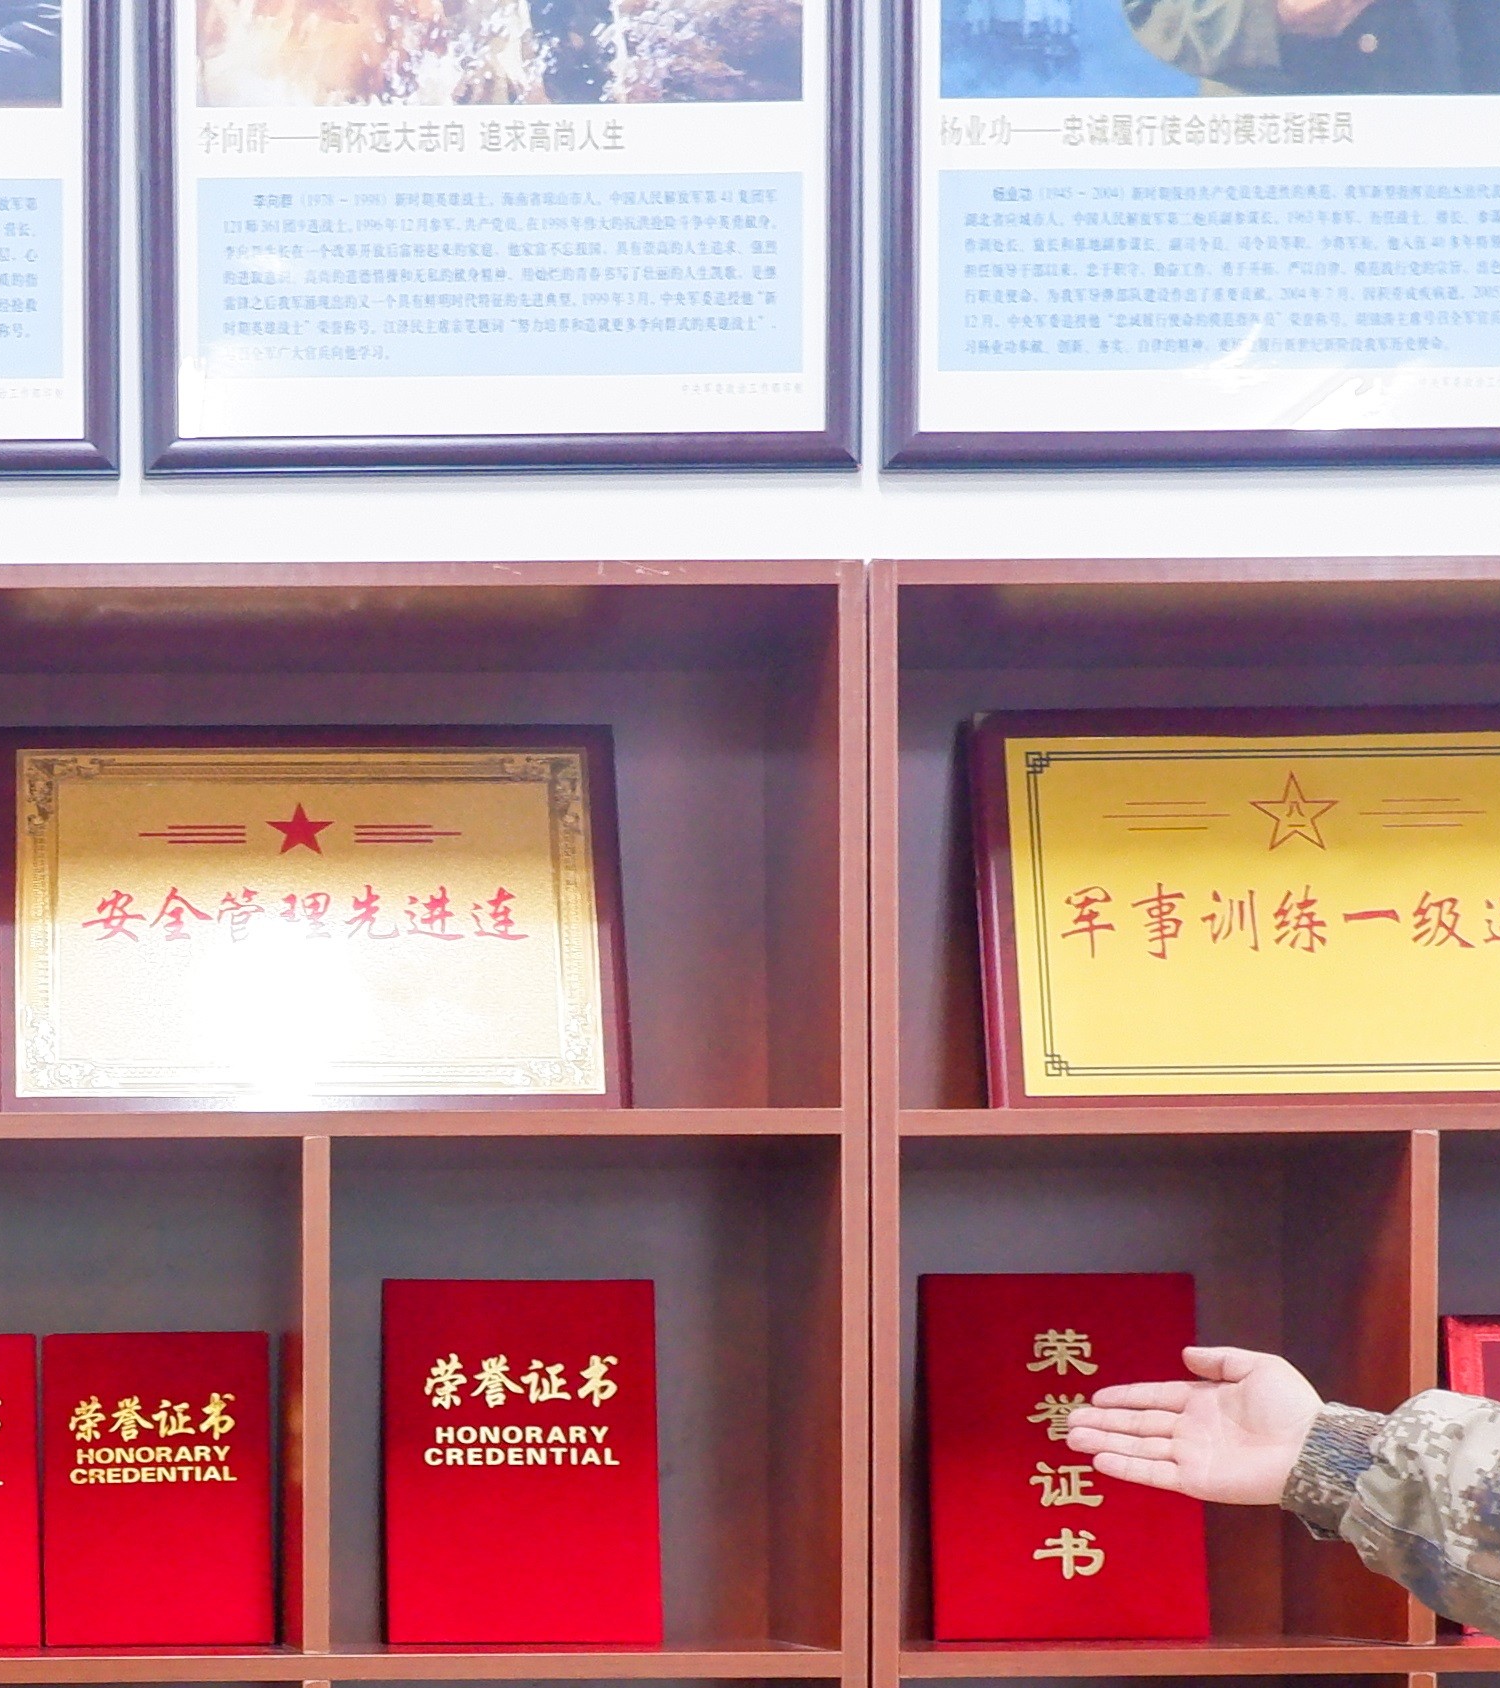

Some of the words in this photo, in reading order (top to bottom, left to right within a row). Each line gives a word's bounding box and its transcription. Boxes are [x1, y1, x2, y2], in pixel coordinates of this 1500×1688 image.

[82, 884, 529, 942] 安全管理先进连
[424, 1353, 620, 1410] 荣誉证书
[68, 1392, 237, 1443] 荣誉证书
[435, 1425, 610, 1445] HONORARY
[76, 1445, 232, 1466] HONORARY
[424, 1447, 621, 1467] CREDENTIAL
[1026, 1328, 1105, 1581] 荣誉证书
[69, 1464, 238, 1486] CREDENTIAL
